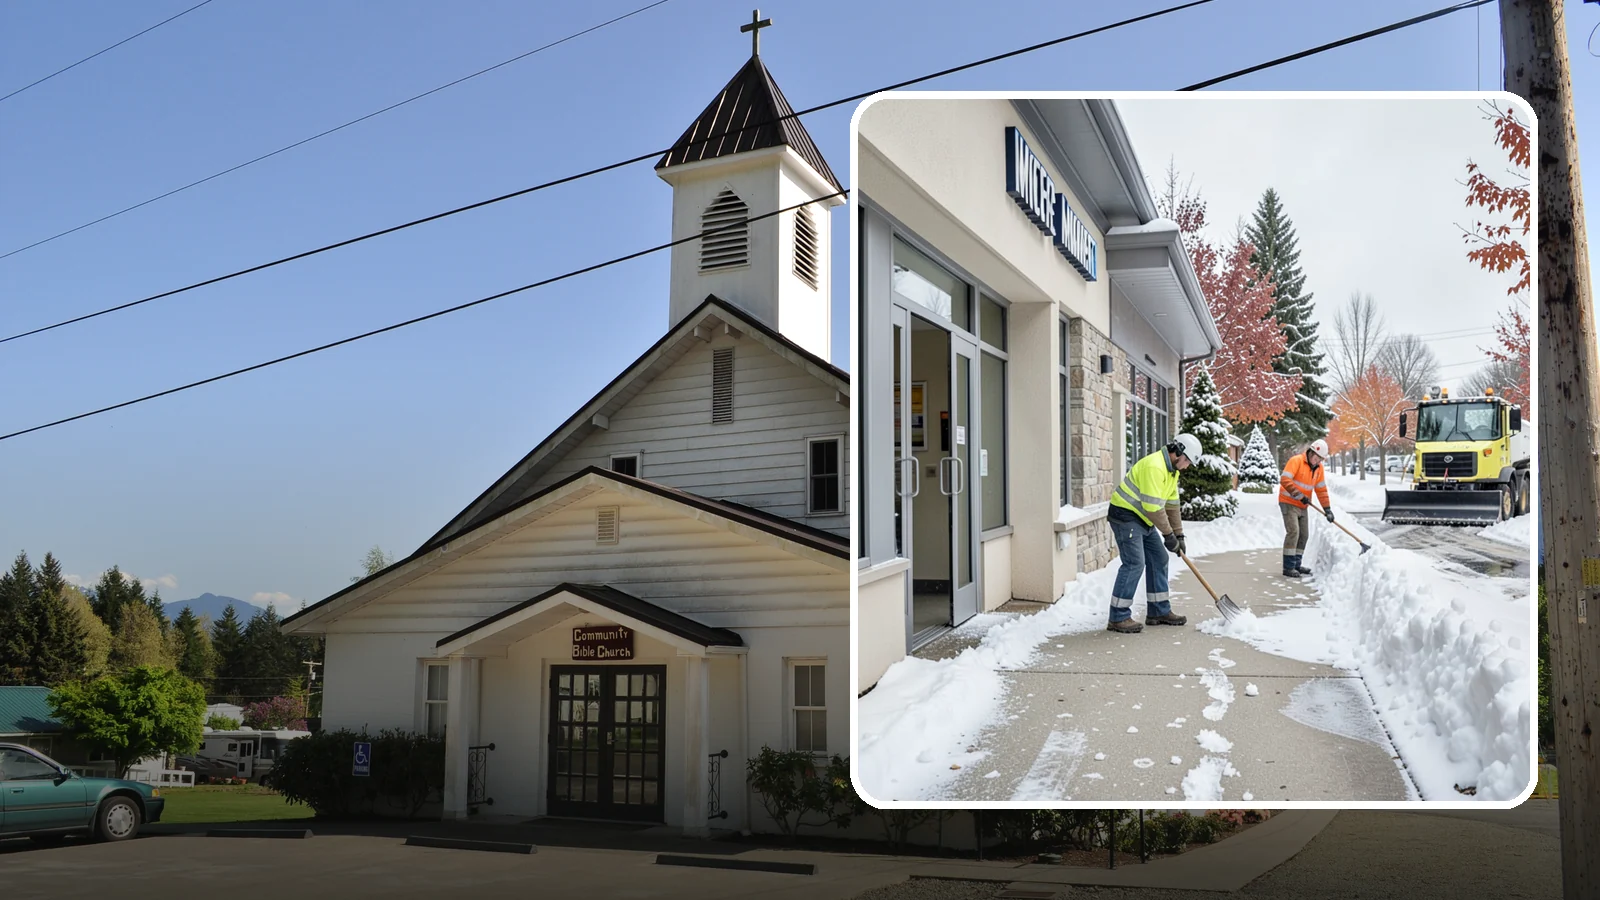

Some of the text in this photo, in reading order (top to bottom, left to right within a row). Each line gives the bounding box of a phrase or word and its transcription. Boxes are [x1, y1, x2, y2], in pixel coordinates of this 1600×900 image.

[574, 627, 628, 642] Community
[572, 645, 631, 658] Bible Church
